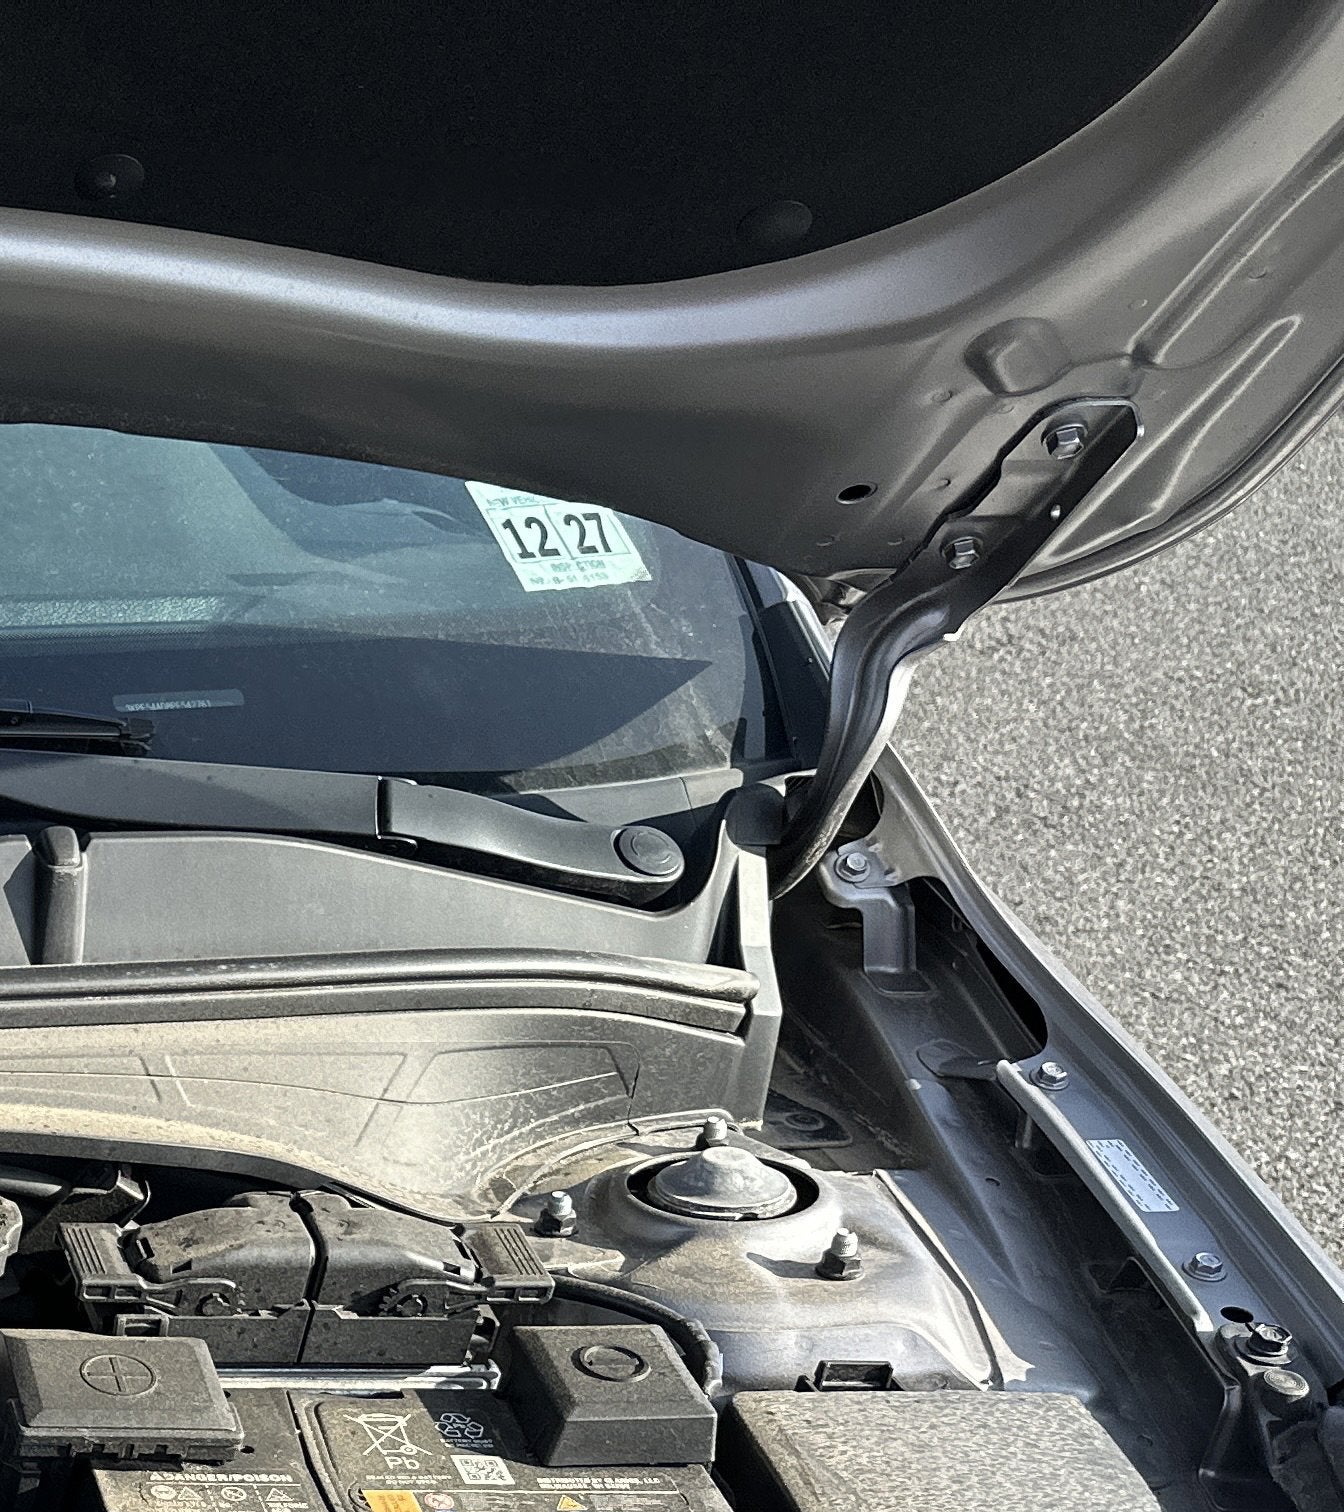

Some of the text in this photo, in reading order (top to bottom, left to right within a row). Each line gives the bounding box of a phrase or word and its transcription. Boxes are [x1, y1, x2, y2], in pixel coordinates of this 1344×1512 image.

[501, 512, 613, 560] 12 27
[384, 1456, 420, 1470] Pb
[163, 1473, 294, 1483] DANGER/POISON
